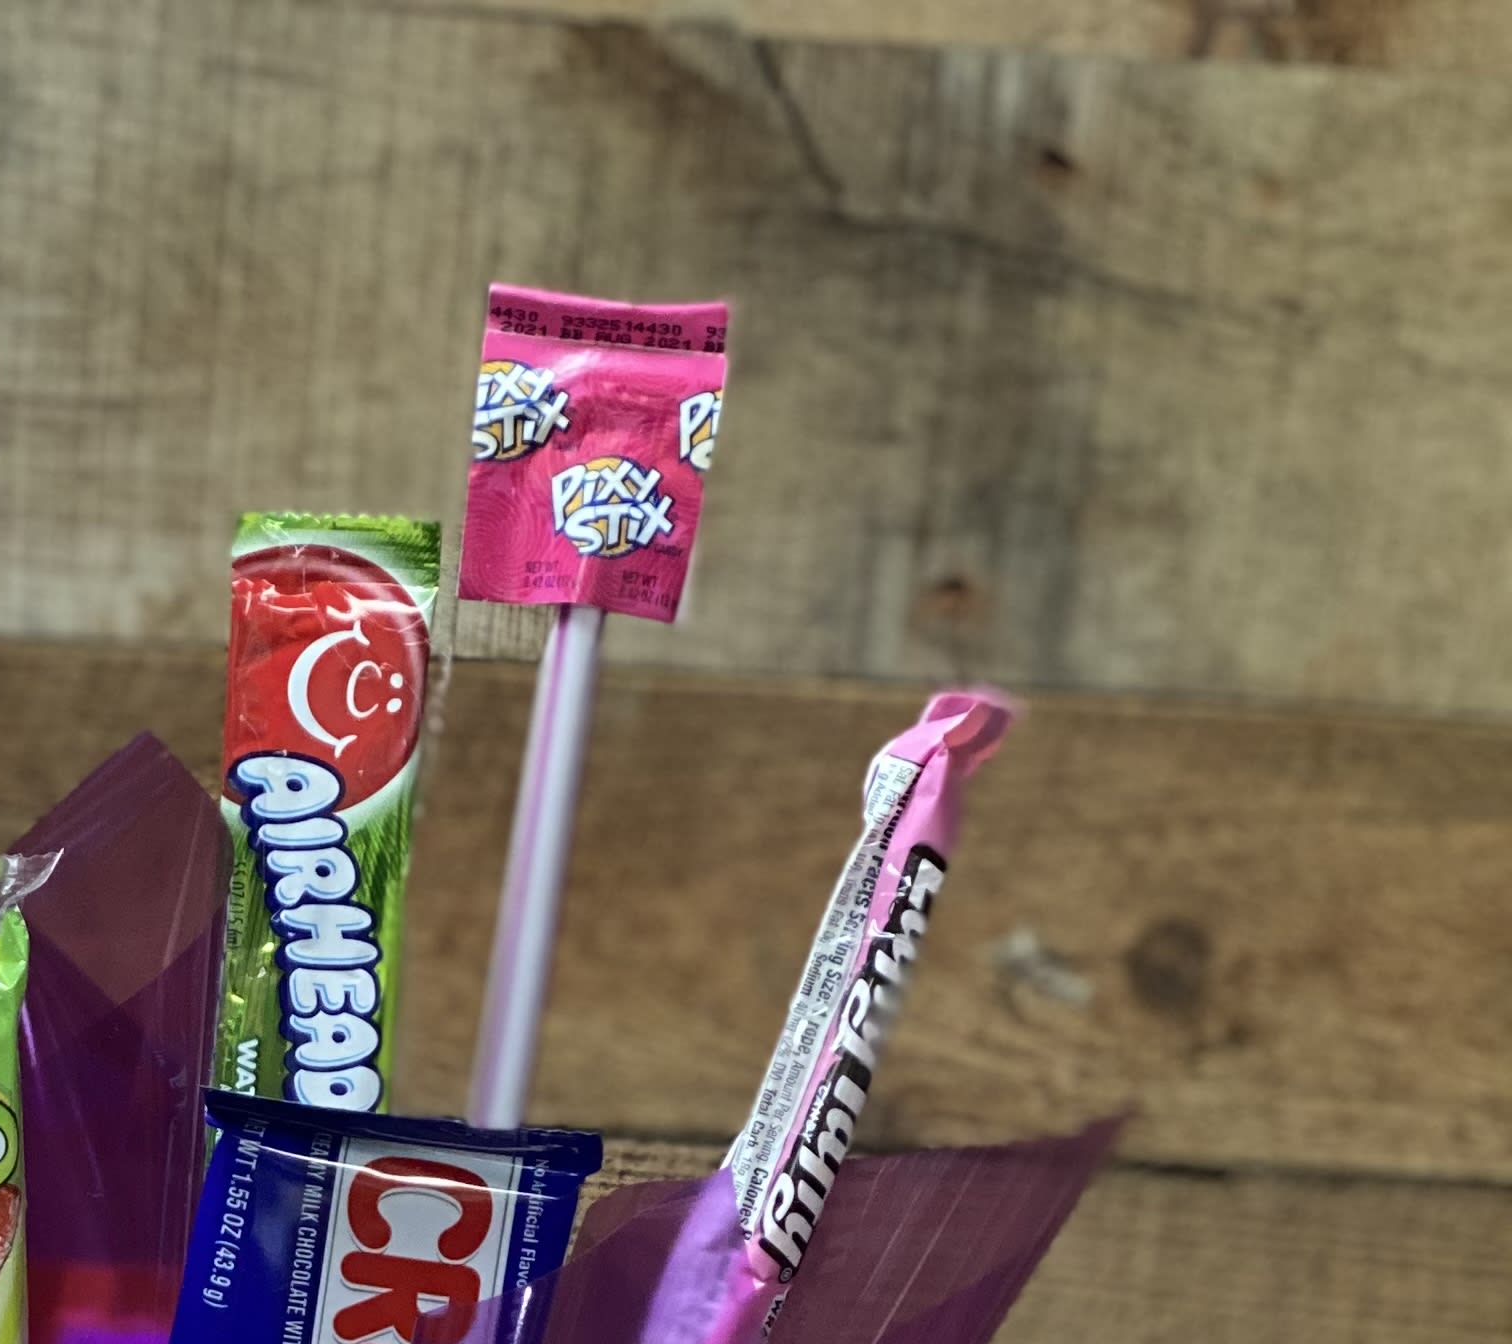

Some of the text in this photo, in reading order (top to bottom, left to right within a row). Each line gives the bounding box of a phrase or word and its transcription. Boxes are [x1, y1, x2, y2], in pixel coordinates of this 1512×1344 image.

[755, 1087, 778, 1117] Total
[224, 1170, 253, 1210] 1.55
[298, 1183, 324, 1223] MILK
[218, 1212, 245, 1239] OZ
[285, 1225, 318, 1316] CHOCOLATE
